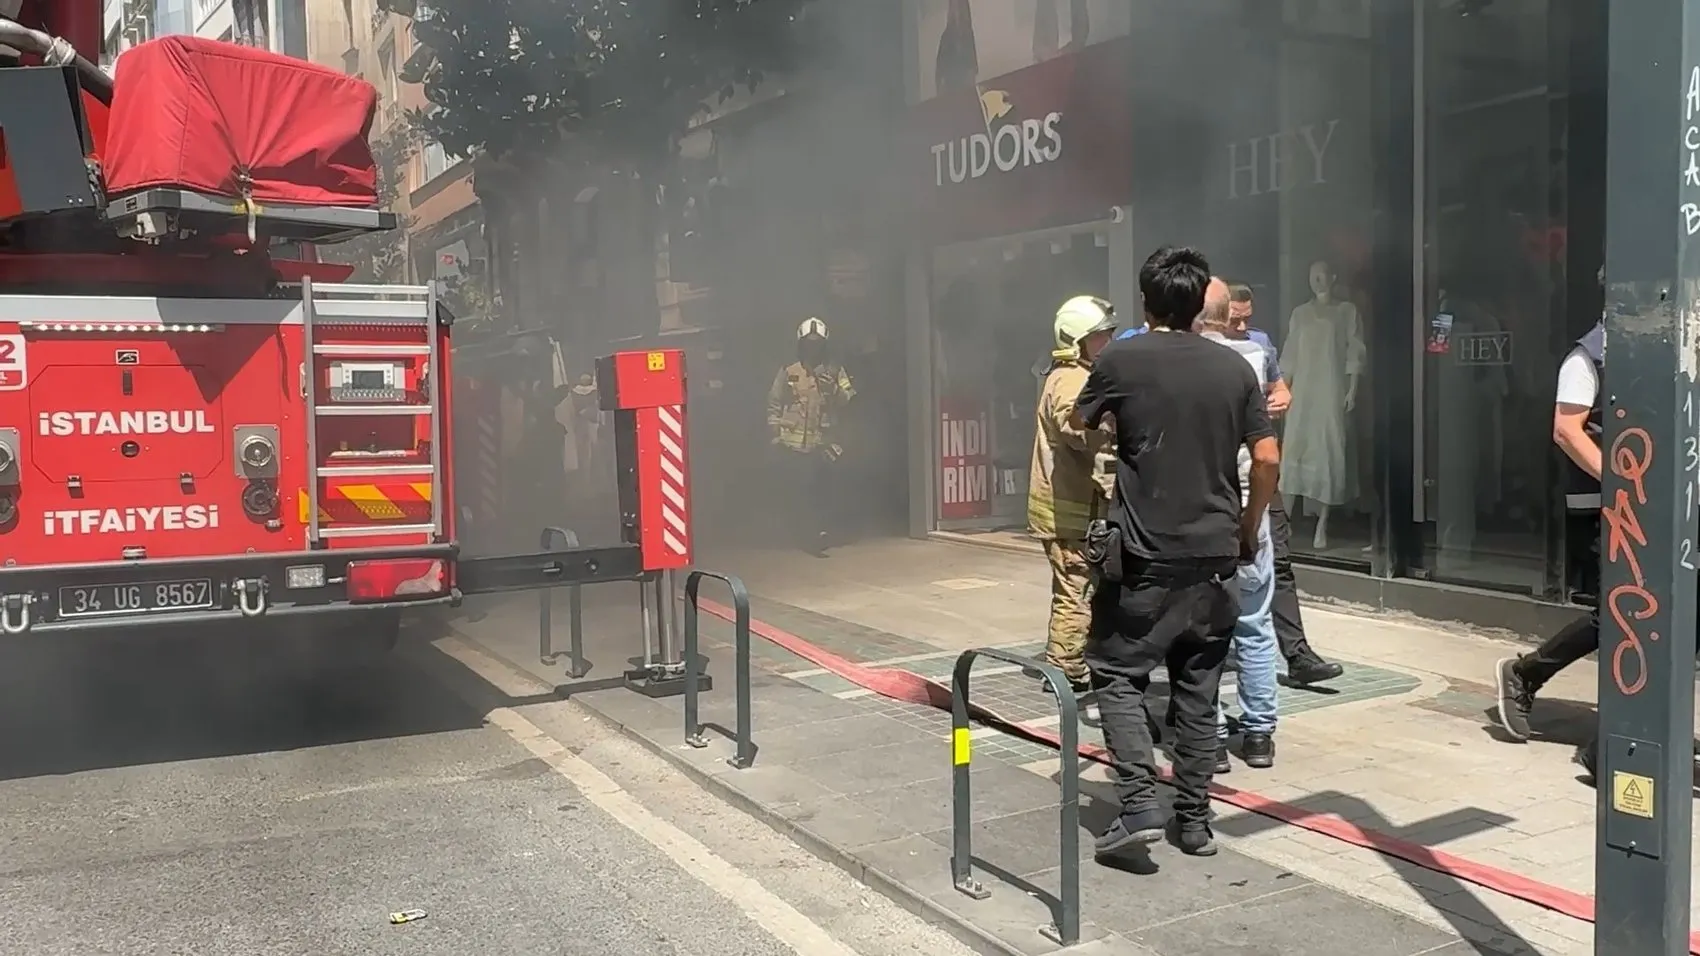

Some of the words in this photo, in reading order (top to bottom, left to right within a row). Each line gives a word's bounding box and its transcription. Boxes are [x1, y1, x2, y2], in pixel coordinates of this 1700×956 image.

[931, 111, 1063, 186] TUDORS
[1226, 119, 1340, 199] HEY
[1460, 337, 1508, 360] HEY
[74, 588, 102, 612] 34
[114, 586, 141, 608] UG
[156, 582, 208, 606] 8567
